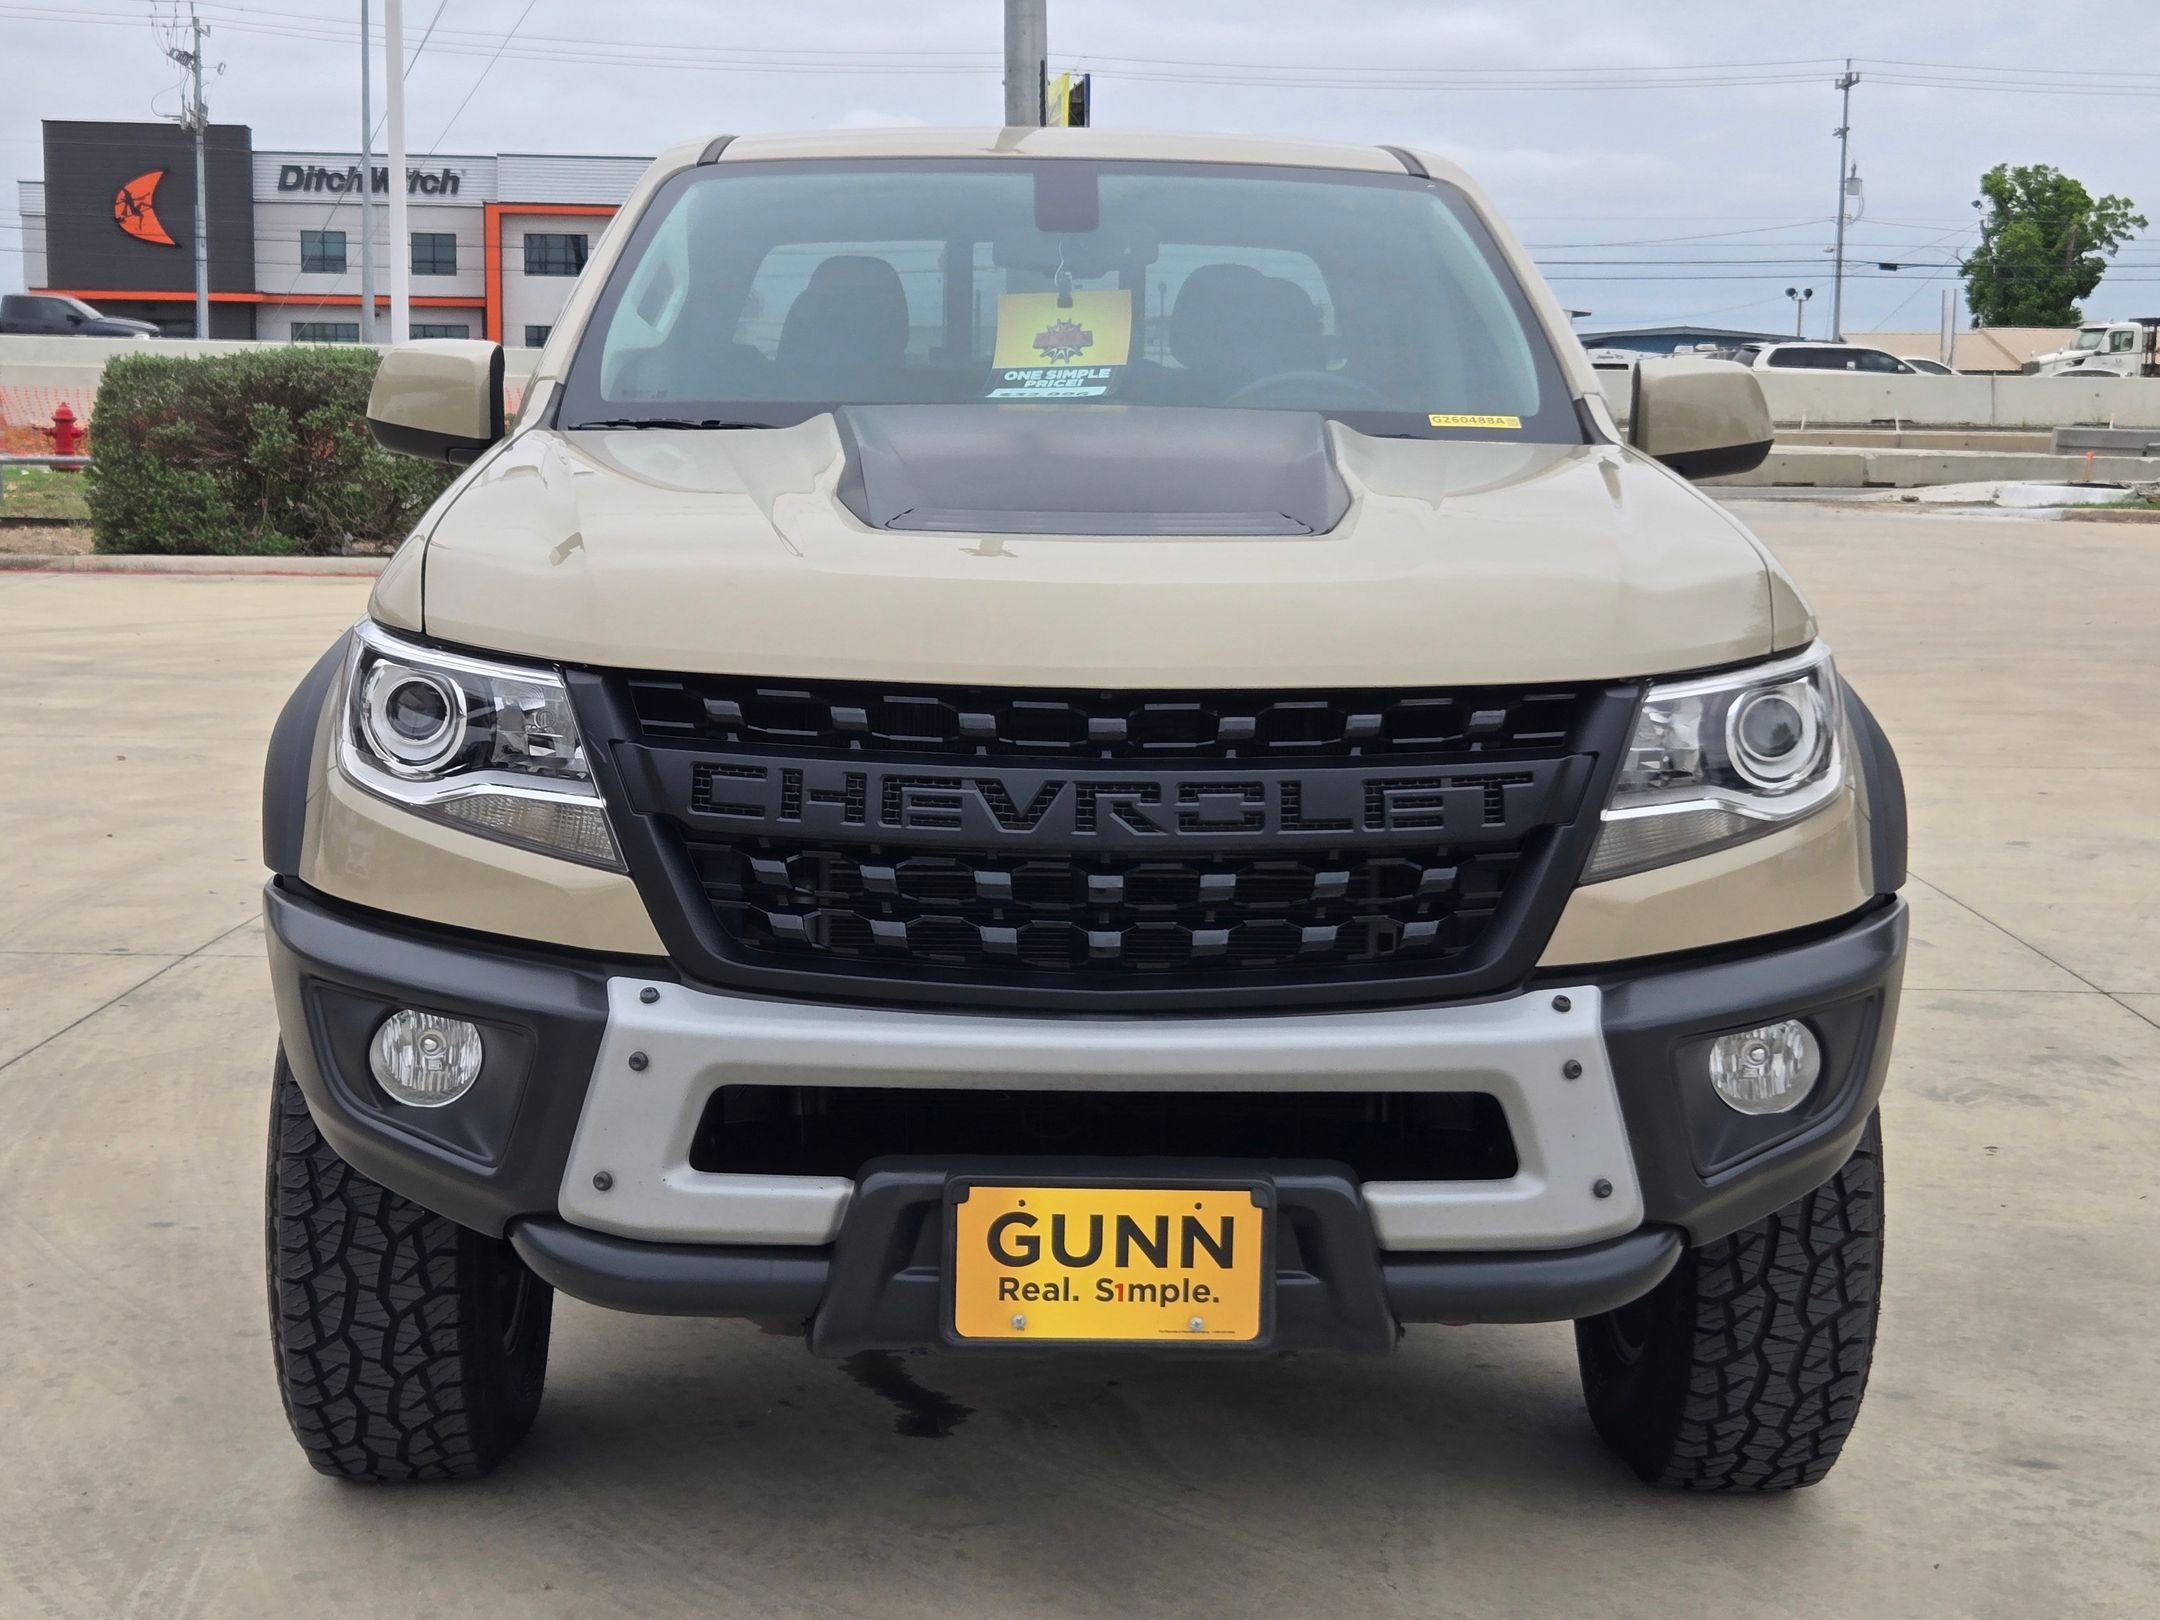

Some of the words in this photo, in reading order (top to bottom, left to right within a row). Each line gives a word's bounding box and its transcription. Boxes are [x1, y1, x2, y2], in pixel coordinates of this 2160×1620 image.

[278, 165, 363, 192] Ditch
[1004, 370, 1043, 381] ONE
[1046, 368, 1111, 379] SIMPLE
[689, 761, 1535, 836] CHEVROLET
[987, 1211, 1234, 1269] GUNN
[999, 1277, 1079, 1302] Real.
